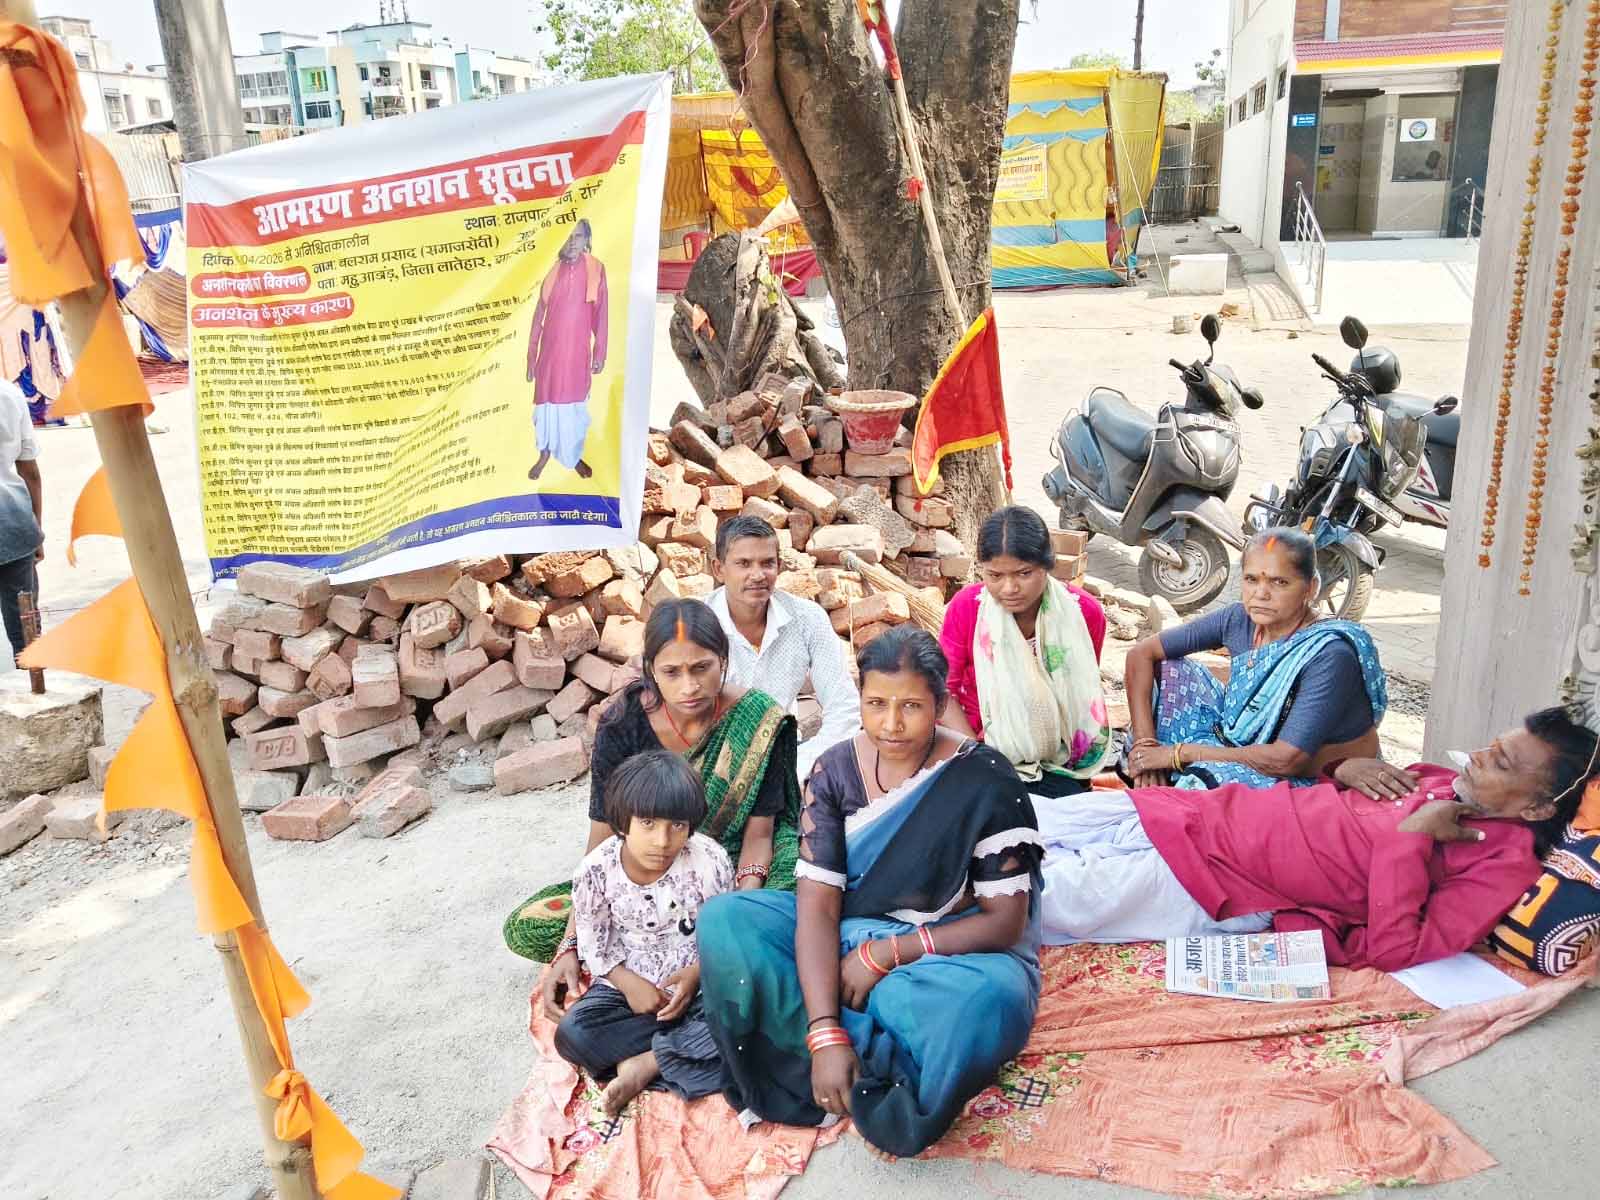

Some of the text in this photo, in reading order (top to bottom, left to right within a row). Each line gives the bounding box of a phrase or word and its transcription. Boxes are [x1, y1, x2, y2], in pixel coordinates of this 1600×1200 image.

[253, 152, 575, 237] आमरण अनशन सूचना
[295, 234, 370, 258] अनिश्चितकालीन
[381, 247, 417, 263] प्रसाद
[401, 262, 434, 278] जिला
[310, 295, 352, 316] कारण
[487, 510, 538, 525] अनिश्चितकाल
[539, 510, 558, 520] तक
